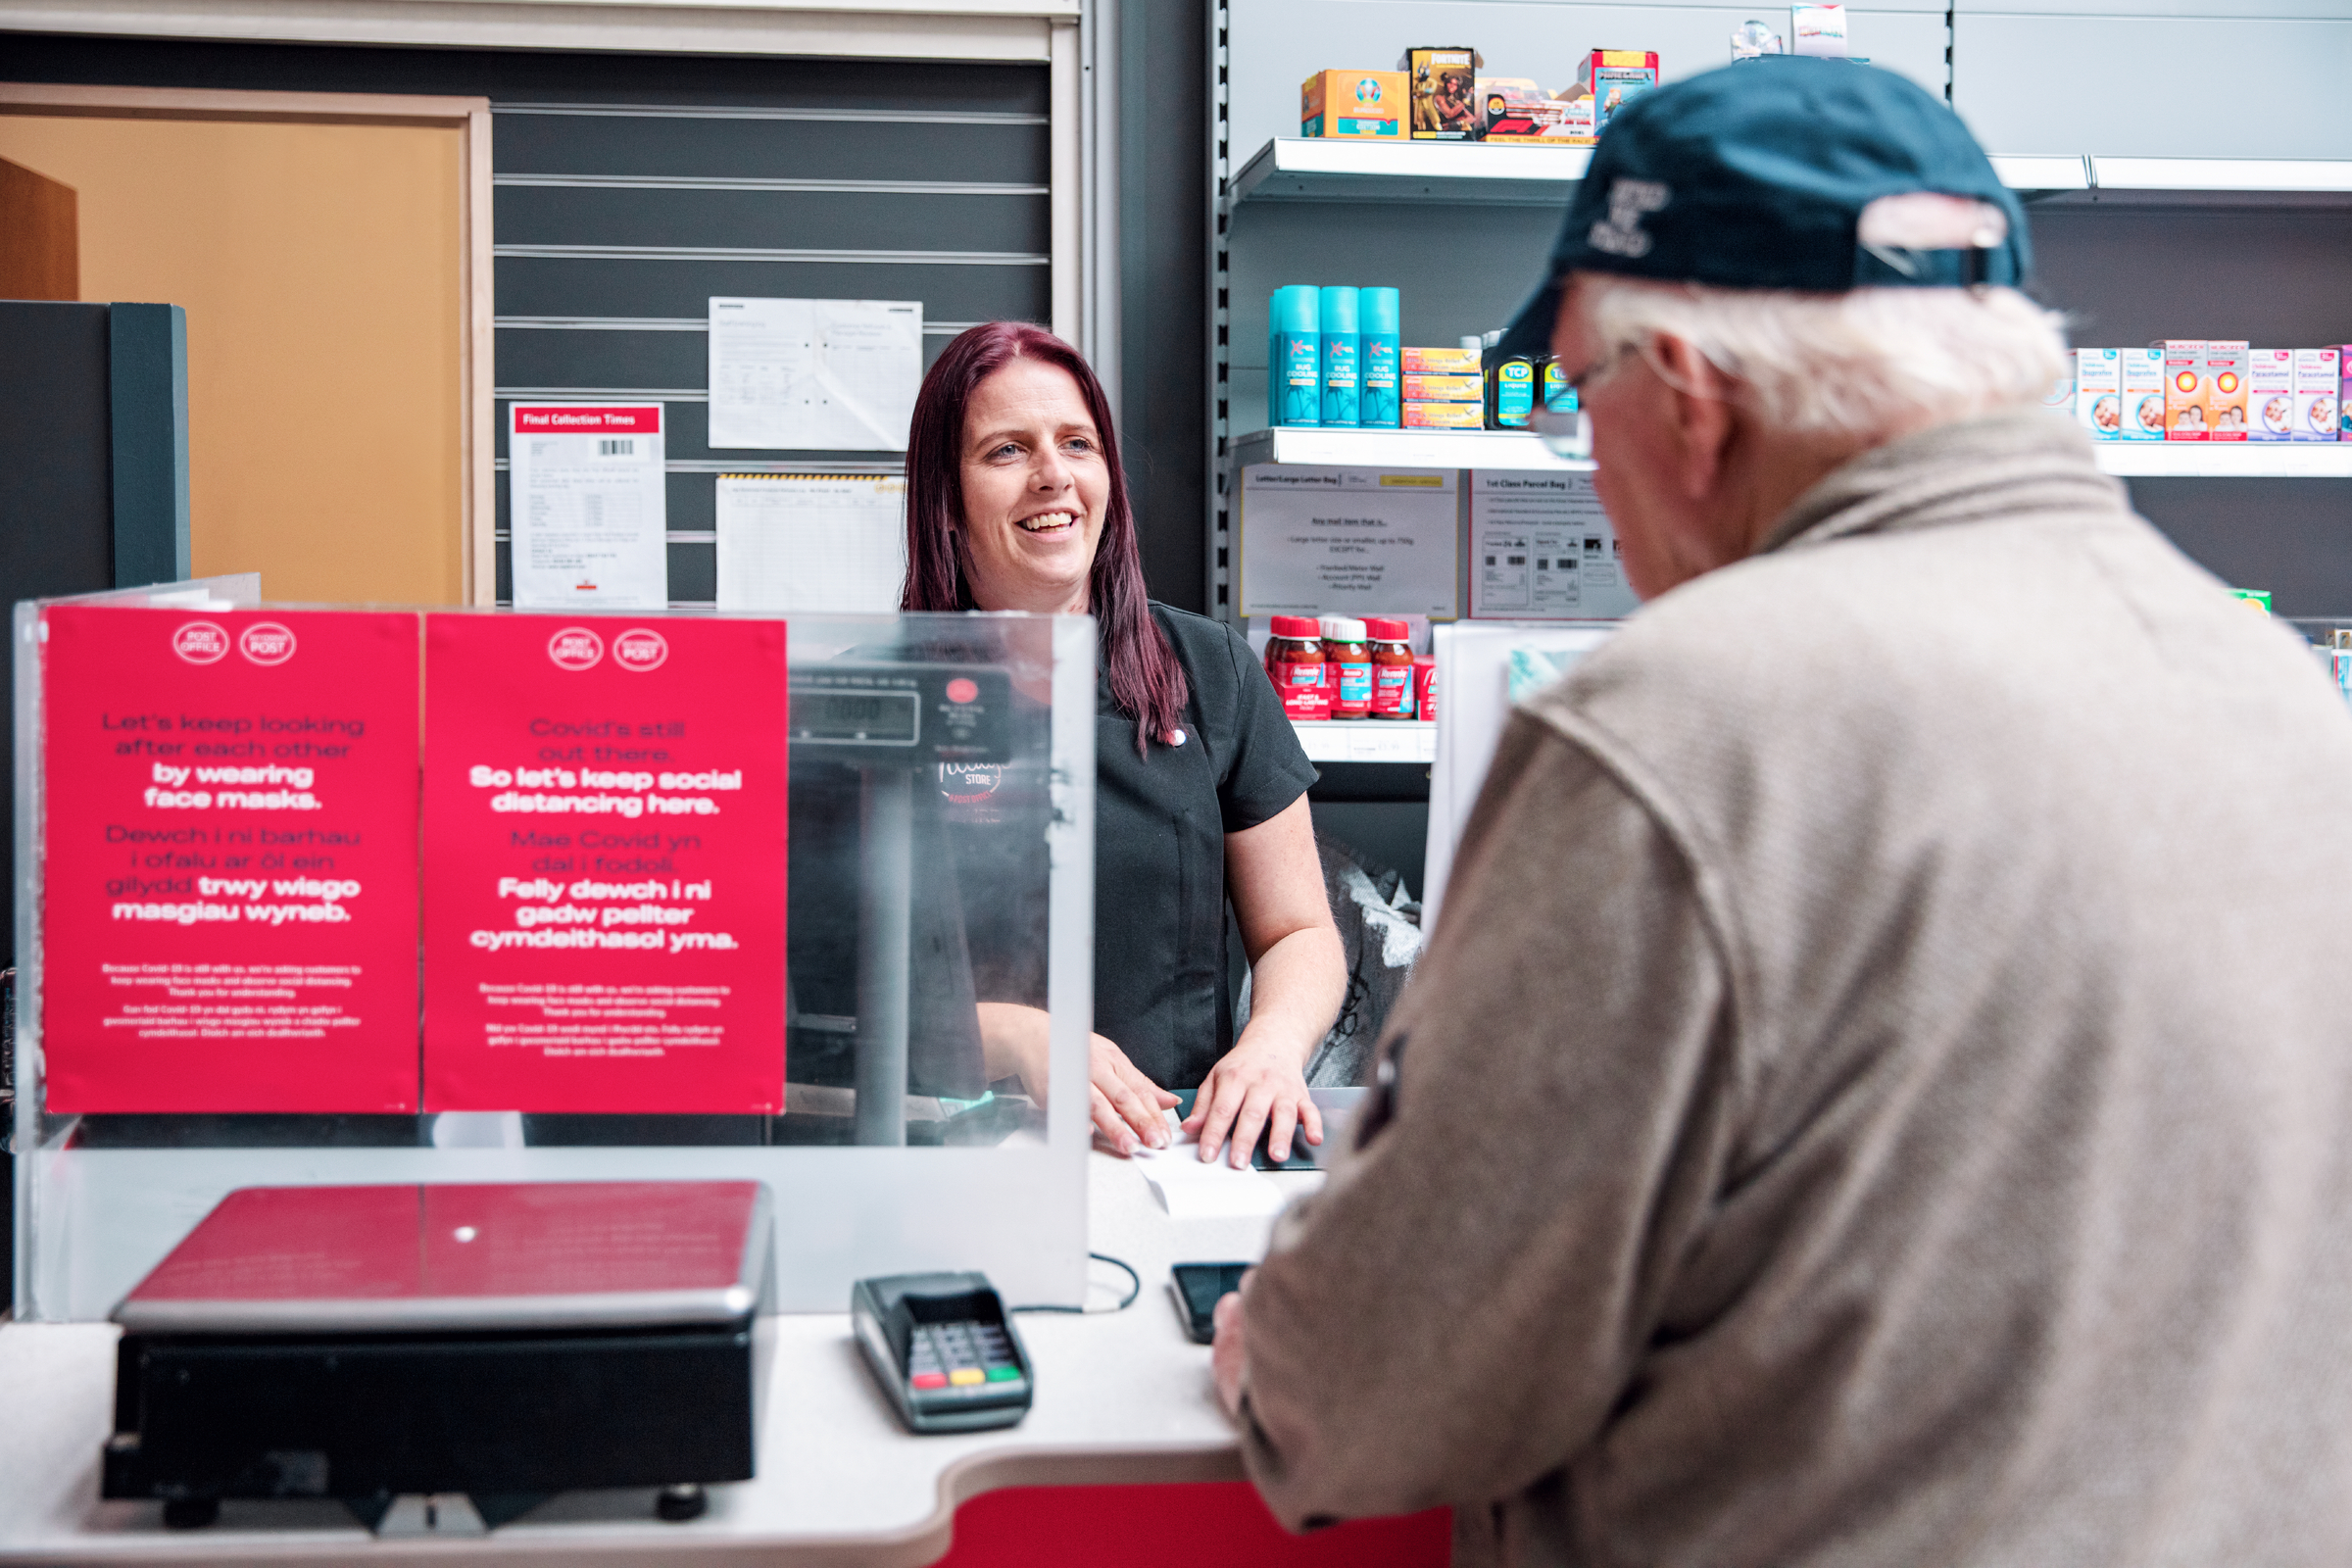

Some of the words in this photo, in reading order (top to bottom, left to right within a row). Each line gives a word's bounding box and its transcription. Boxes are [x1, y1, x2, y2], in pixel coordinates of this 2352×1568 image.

[1431, 53, 1470, 65] FORTNITE
[1507, 367, 1528, 377] TCP
[523, 414, 549, 425] Final
[551, 414, 602, 425] Collection
[604, 414, 635, 425] Times
[1523, 480, 1548, 489] Parcel
[1550, 480, 1566, 490] Bag
[187, 632, 218, 642] POST
[180, 643, 220, 653] OFFICE
[251, 642, 285, 654] POST
[556, 648, 594, 659] OFFICE
[623, 648, 657, 661] POST
[1294, 667, 1319, 676] Rennie
[1381, 668, 1407, 678] Rennie
[102, 713, 172, 732] Let's
[180, 714, 251, 734] keep
[261, 715, 365, 738] looking
[529, 717, 631, 738] Covid's
[639, 721, 686, 740] still
[116, 739, 184, 757] after
[195, 739, 266, 758] each
[273, 739, 351, 759] other
[539, 747, 585, 762] out
[594, 747, 675, 763] there.
[153, 762, 189, 788] by
[196, 764, 314, 788] wearing
[469, 764, 513, 788] So
[515, 766, 577, 788] let's
[581, 766, 655, 793] keep
[658, 769, 743, 790] social
[965, 774, 991, 785] STORE
[145, 788, 212, 808] face
[218, 789, 322, 809] masks.
[491, 791, 643, 818] distancing
[649, 794, 720, 815] here.
[971, 791, 991, 803] OFFICE
[106, 825, 208, 844] Dewch
[216, 826, 221, 844] i
[227, 827, 253, 844] ni
[261, 827, 361, 846] barhau
[510, 831, 571, 850] Mae
[579, 830, 660, 851] Covid
[666, 835, 702, 854] yn
[131, 851, 137, 867] i
[145, 852, 216, 869] ofalu
[224, 856, 252, 869] ar
[292, 854, 335, 870] ein
[532, 857, 574, 873] dal
[581, 857, 587, 873] i
[595, 857, 679, 874] fodoli.
[105, 876, 192, 898] gilydd
[198, 876, 268, 900] trwy
[272, 876, 362, 902] wisgo
[498, 877, 566, 904] Felly
[568, 878, 668, 901] dewch
[672, 879, 681, 901] i
[686, 879, 711, 901] ni
[112, 900, 239, 925] masgiau
[244, 902, 351, 926] wyneb.
[515, 904, 598, 927] gadw
[602, 904, 696, 928] pellter
[470, 927, 665, 953] cymdeithasol
[669, 930, 739, 955] yma.
